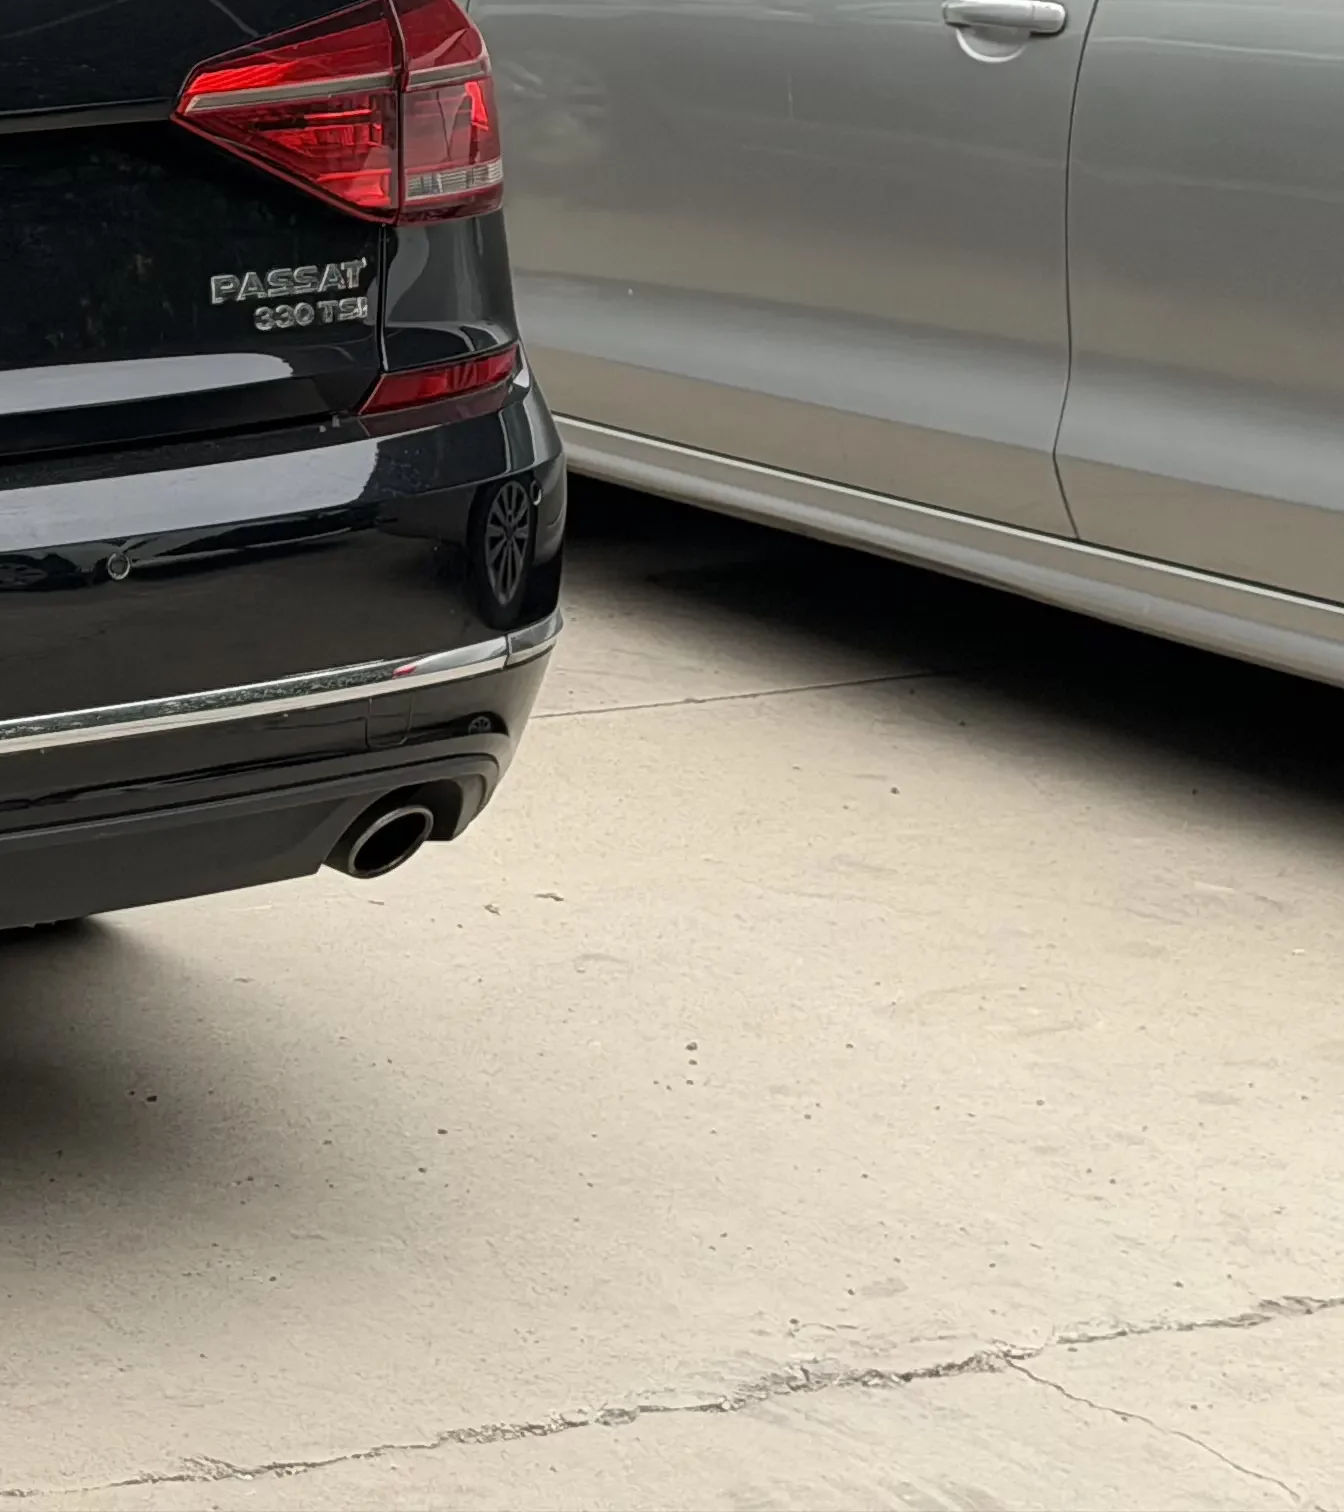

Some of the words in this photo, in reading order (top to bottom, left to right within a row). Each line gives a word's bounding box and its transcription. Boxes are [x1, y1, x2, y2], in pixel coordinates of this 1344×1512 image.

[210, 256, 368, 305] PASSAT
[254, 302, 315, 330] 330
[318, 296, 368, 324] TSI
